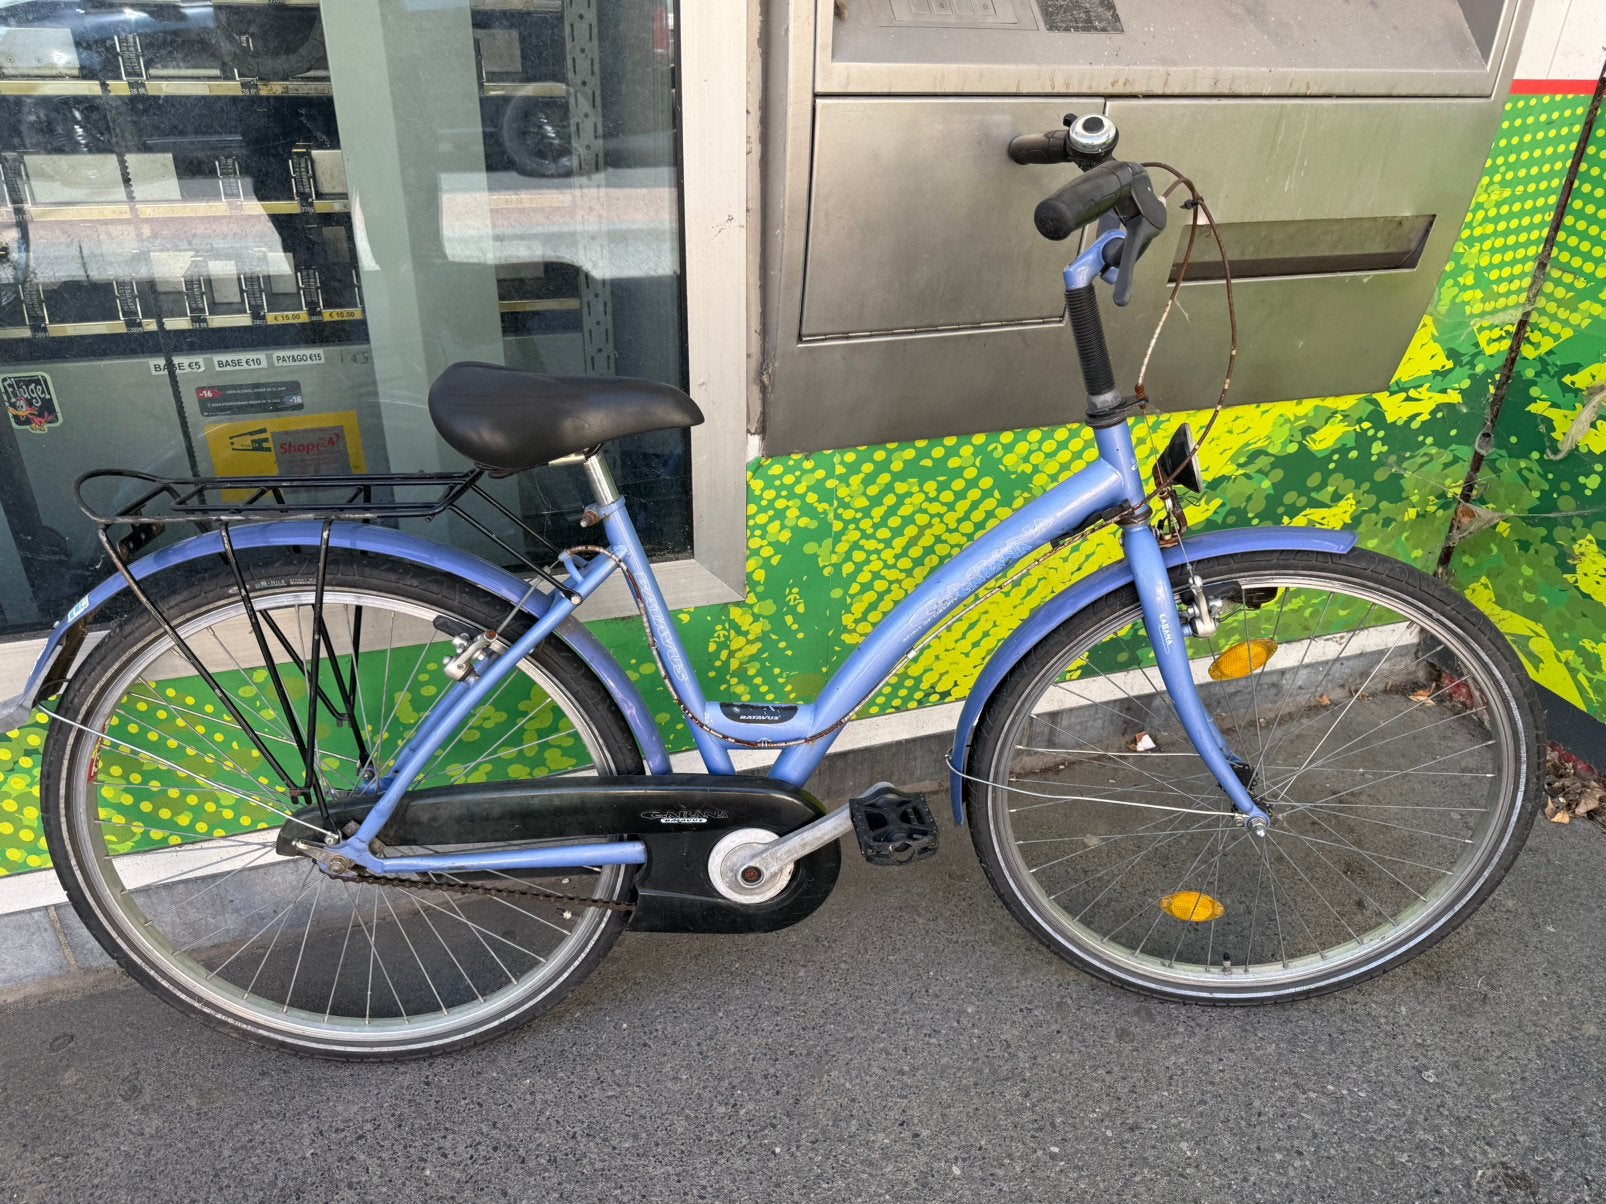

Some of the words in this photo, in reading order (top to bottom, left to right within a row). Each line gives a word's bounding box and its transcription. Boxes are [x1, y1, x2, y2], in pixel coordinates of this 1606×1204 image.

[217, 359, 244, 368] BASE
[245, 358, 262, 367] €10
[276, 354, 308, 364] PAY&GO
[309, 353, 322, 362] €15
[188, 361, 201, 370] €5
[3, 375, 50, 407] Flügel
[199, 390, 213, 398] -16
[634, 571, 689, 681] BATAVUS
